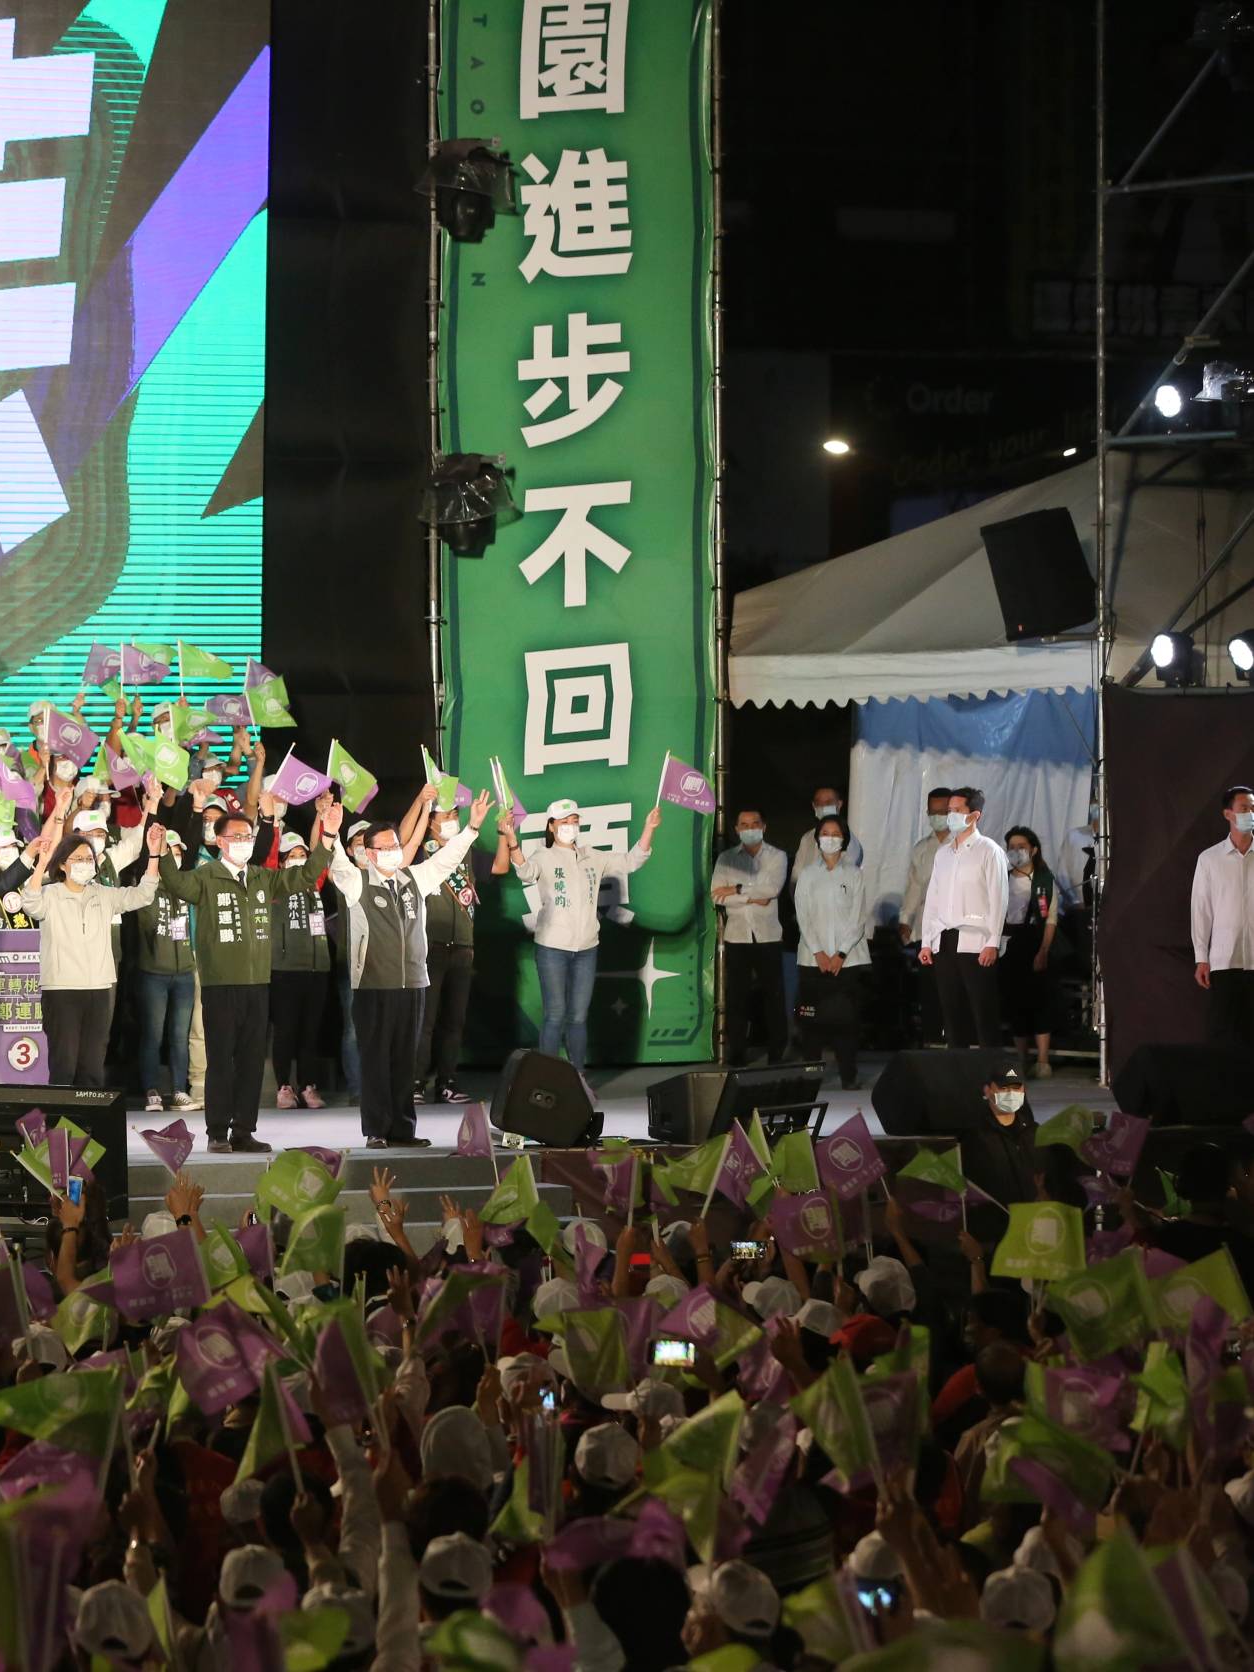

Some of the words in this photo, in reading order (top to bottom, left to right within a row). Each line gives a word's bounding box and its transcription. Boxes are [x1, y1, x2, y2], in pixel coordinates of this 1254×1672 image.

[469, 14, 487, 288] TAON
[906, 382, 994, 416] Order
[216, 892, 235, 943] 鄭運鵬
[16, 1043, 31, 1066] 3
